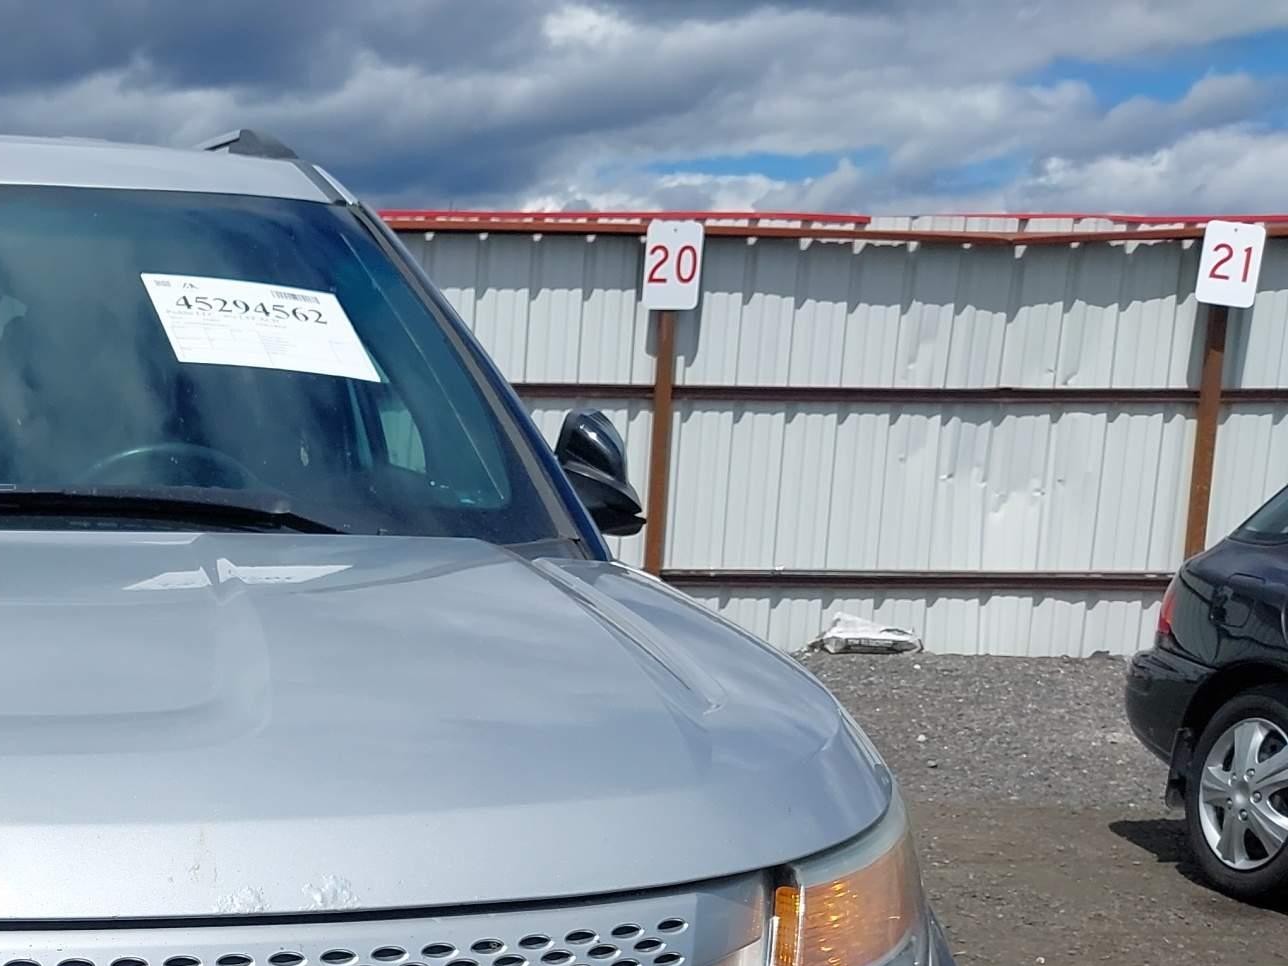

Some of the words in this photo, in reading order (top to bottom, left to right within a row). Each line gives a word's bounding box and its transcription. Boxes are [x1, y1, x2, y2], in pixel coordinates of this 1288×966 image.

[648, 245, 697, 284] 20
[1209, 243, 1253, 283] 21
[176, 295, 328, 325] 45294562
